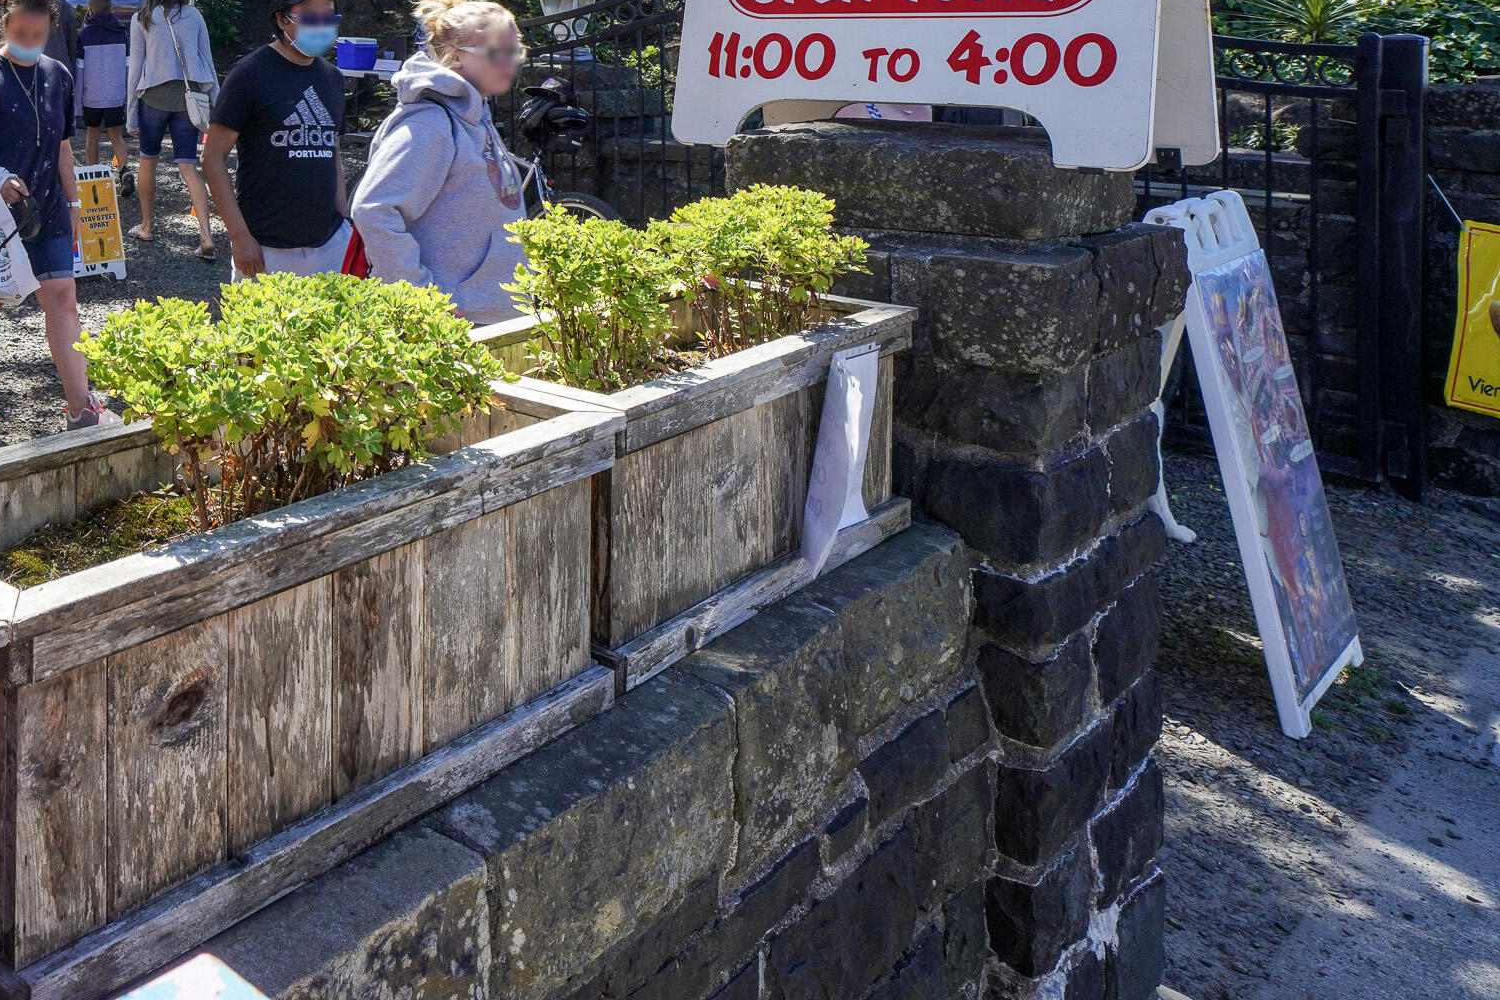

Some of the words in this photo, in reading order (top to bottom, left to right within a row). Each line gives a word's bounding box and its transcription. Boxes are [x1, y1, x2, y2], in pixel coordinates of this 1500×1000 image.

[707, 32, 836, 80] 11:00
[946, 29, 1118, 87] 4:00
[288, 149, 333, 158] PORTLAND
